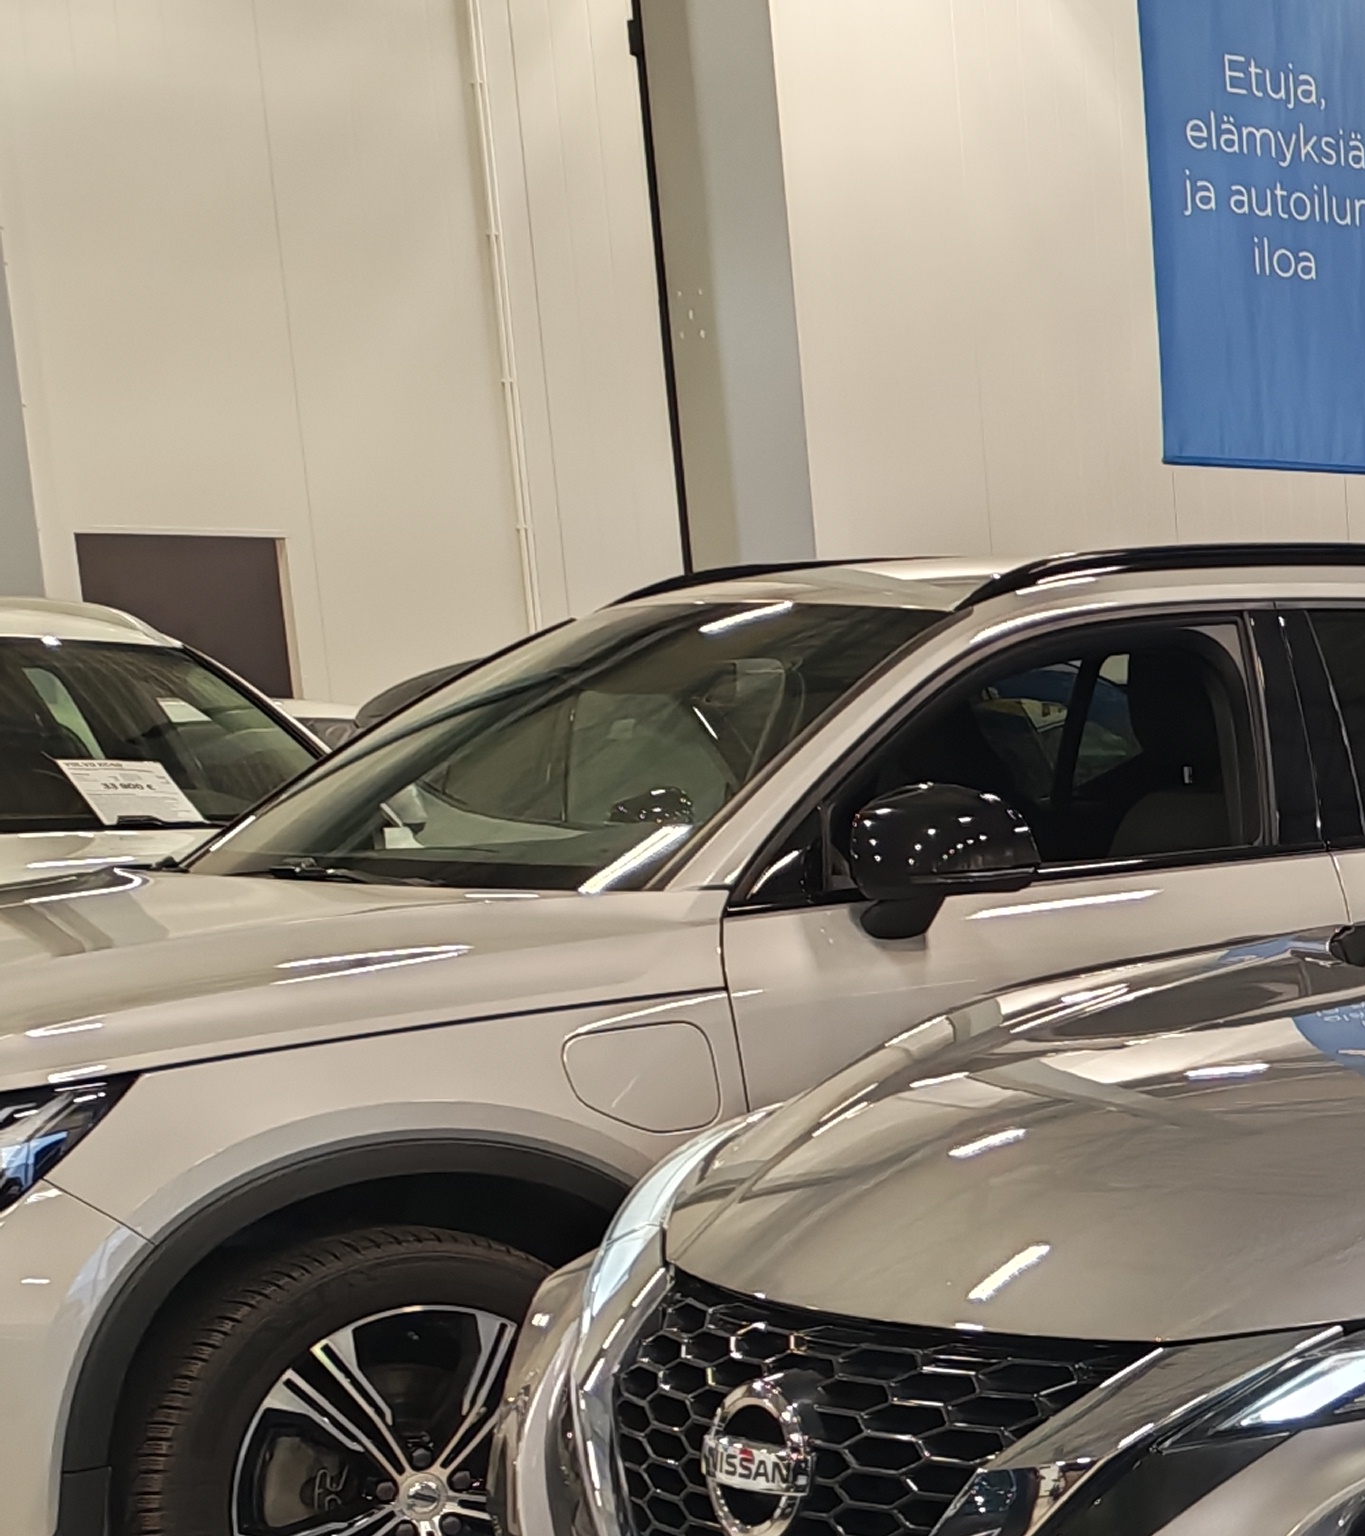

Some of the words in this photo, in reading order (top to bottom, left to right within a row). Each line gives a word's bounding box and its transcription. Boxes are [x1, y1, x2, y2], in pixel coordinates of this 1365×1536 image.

[1224, 54, 1325, 110] Etuja,
[1186, 110, 1365, 169] elämyksiä
[1183, 169, 1216, 216] ja
[1254, 236, 1316, 280] iloa
[703, 1448, 792, 1484] NISSAN
